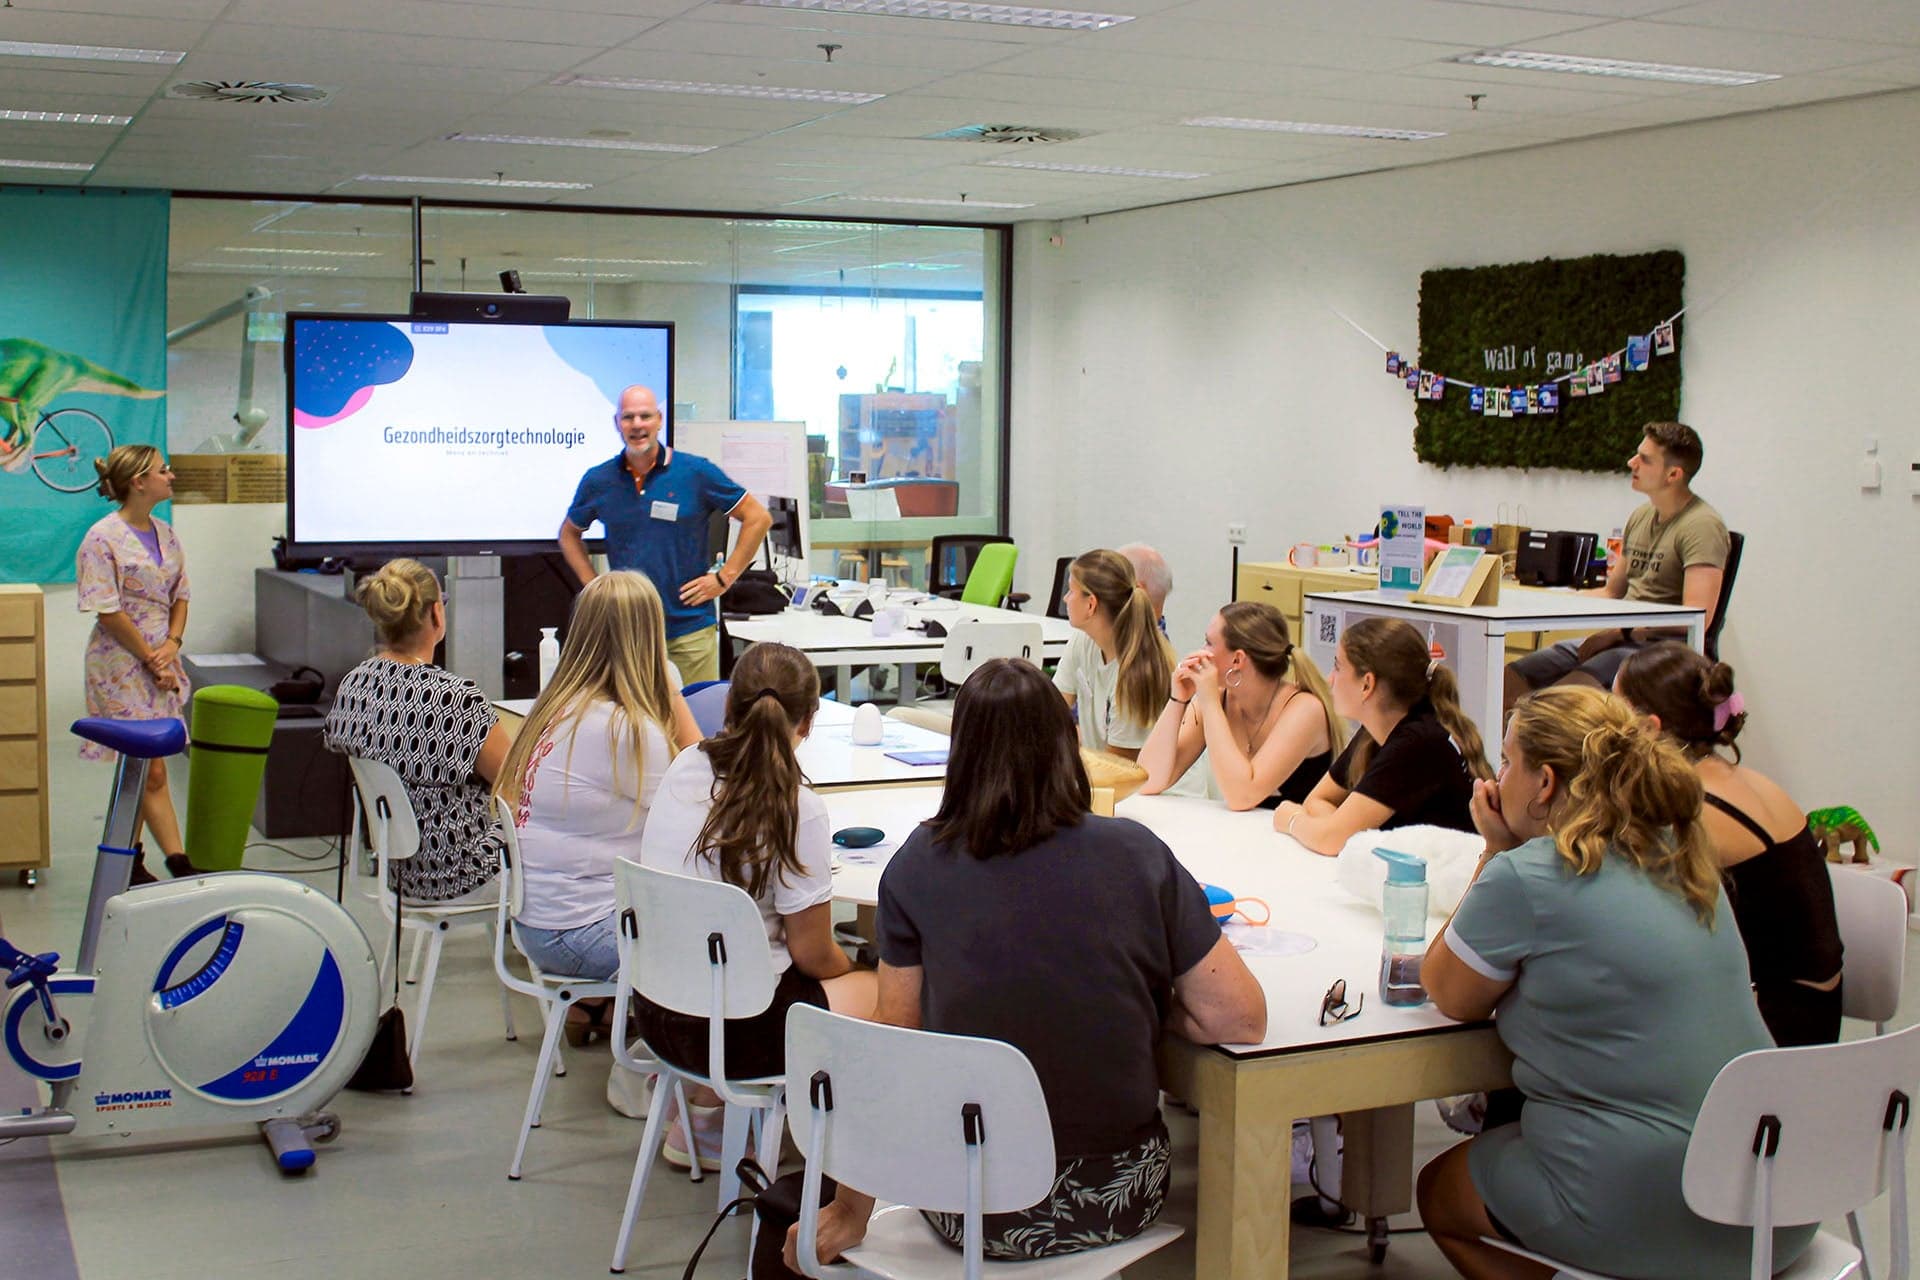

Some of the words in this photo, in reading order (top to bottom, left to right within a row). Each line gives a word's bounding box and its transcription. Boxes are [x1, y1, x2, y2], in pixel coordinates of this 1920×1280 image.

[1484, 345, 1517, 372] Wall
[1523, 345, 1536, 369] of
[1546, 351, 1583, 375] game
[383, 426, 586, 449] Gezondheidszorgtechnologie
[268, 1053, 320, 1067] MONARK
[111, 1088, 172, 1104] MONARK
[137, 1100, 172, 1109] MEDICAL
